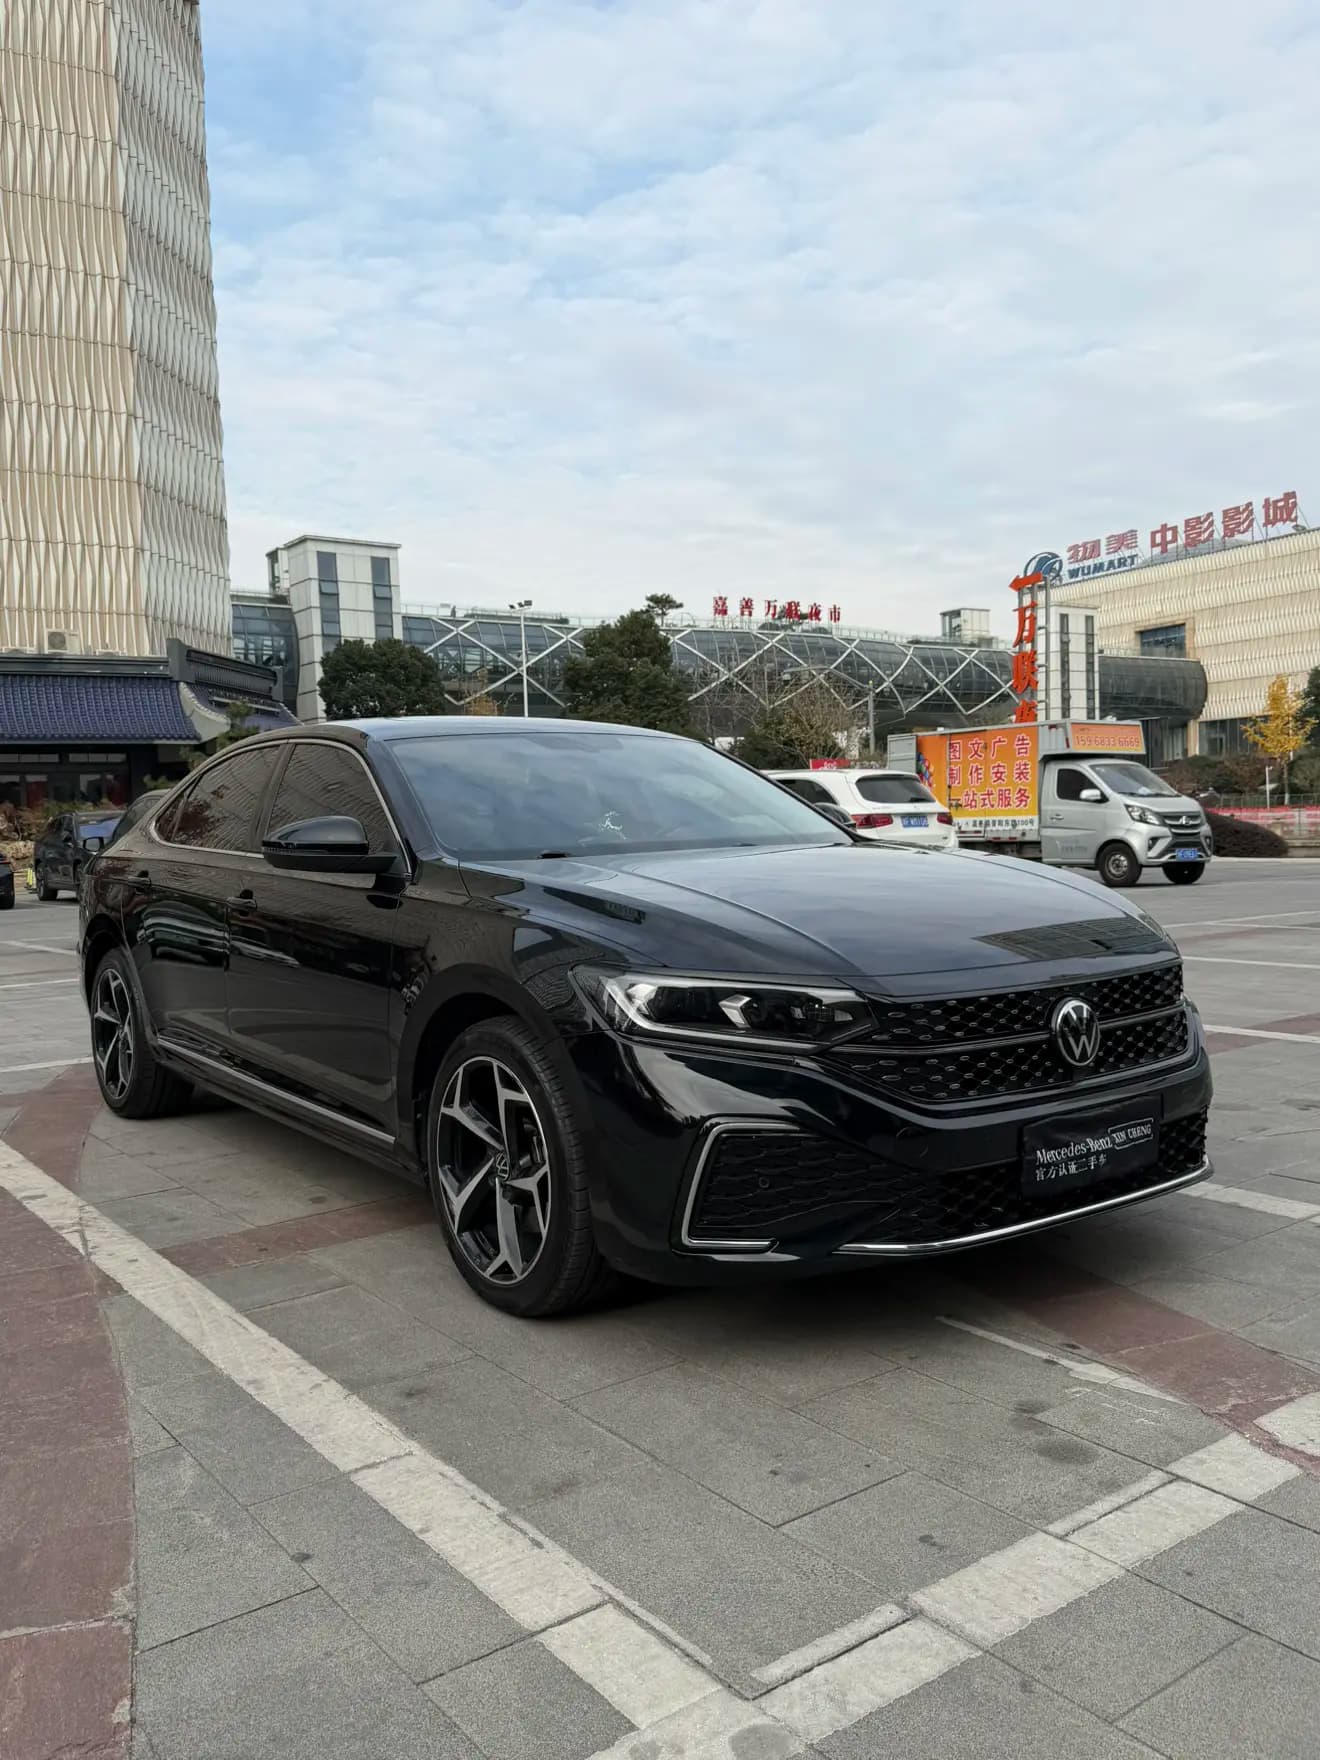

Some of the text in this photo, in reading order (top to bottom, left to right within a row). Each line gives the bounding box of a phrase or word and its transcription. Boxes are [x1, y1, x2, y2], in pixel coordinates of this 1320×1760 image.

[1066, 490, 1298, 565] 物美 中影影城
[1067, 554, 1138, 579] WUMART
[713, 596, 841, 623] 嘉善万联夜市
[948, 734, 1031, 762] 图文广告
[948, 761, 1031, 786] 制作安装
[949, 787, 1031, 810] 一站式服务
[1035, 1124, 1152, 1165] Mercedes-Benz XIN CHENG
[1035, 1153, 1107, 1182] 官方认证二手车
